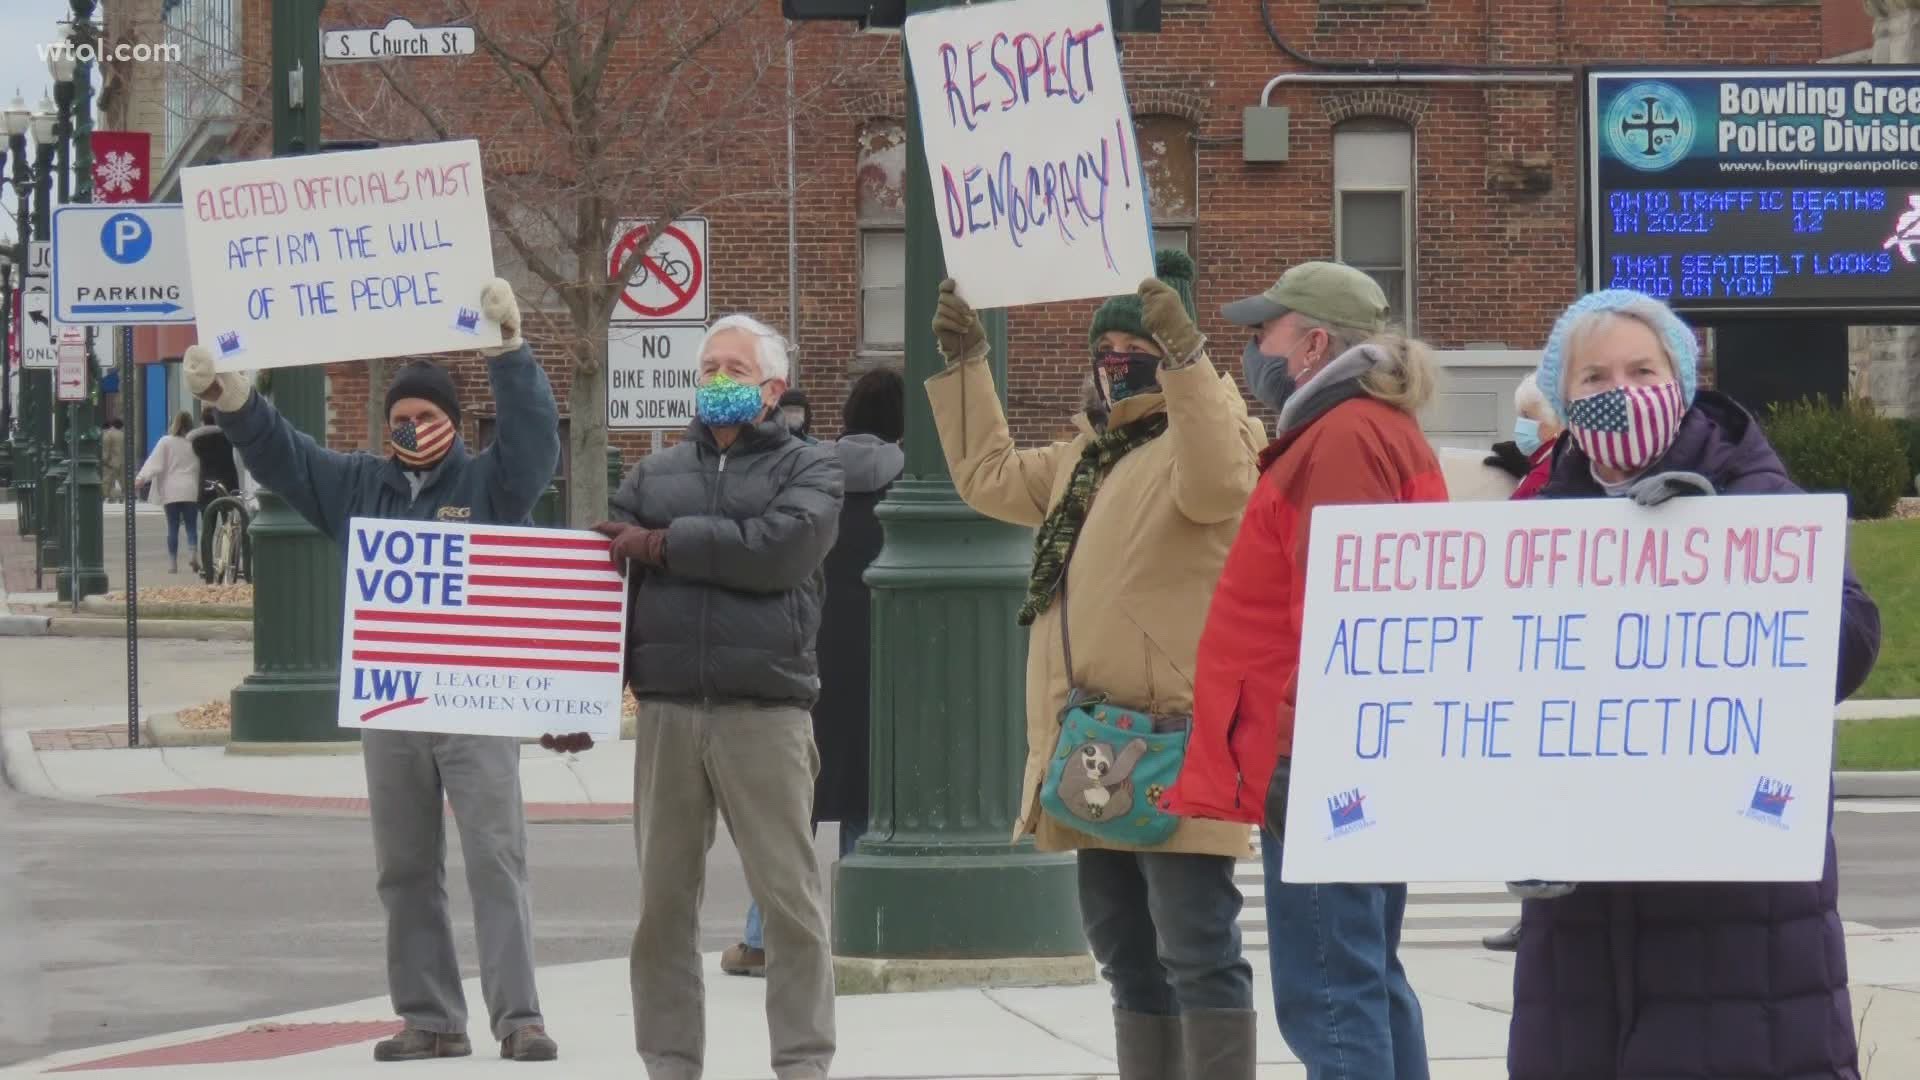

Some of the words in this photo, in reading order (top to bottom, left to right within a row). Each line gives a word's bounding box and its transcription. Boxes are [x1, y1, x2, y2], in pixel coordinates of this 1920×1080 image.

[339, 35, 356, 57] S.
[370, 32, 428, 55] Church
[938, 23, 1104, 131] RESPECT
[1720, 82, 1845, 118] Bowling
[1719, 119, 1817, 153] Police
[196, 180, 288, 221] ELECTED
[294, 168, 409, 211] OFFICIALS
[415, 162, 471, 200] MUST
[941, 118, 1131, 275] DEMOCRACY!
[1609, 190, 1669, 212] OHIO
[1679, 190, 1784, 212] TRAFFIC
[1791, 190, 1887, 211] DEATHS
[1613, 213, 1638, 233] IN
[1647, 213, 1714, 233] 2021:
[1793, 213, 1824, 233] 12
[228, 231, 320, 272] AFFIRM
[328, 225, 376, 260] THE
[388, 219, 452, 253] WILL
[1611, 255, 1672, 275] THAT
[1681, 254, 1804, 275] SEATBELT
[1813, 253, 1891, 274] LOOKS
[77, 286, 180, 301] PARKING
[248, 287, 275, 320] OF
[291, 281, 338, 317] THE
[351, 272, 443, 312] PEOPLE
[1681, 276, 1712, 296] ON
[1721, 276, 1773, 296] YOU!
[642, 335, 671, 359] NO
[612, 369, 645, 389] BIKE
[610, 400, 628, 418] ON
[357, 529, 465, 567] VOTE
[1333, 530, 1486, 593] ELECTED
[1504, 527, 1709, 589] OFFICIALS
[1724, 525, 1823, 584] MUST
[356, 568, 463, 606] VOTE
[1325, 615, 1483, 676] ACCEPT
[1512, 614, 1587, 672] THE
[1615, 610, 1808, 670] OUTCOME
[352, 667, 422, 701] LWV
[435, 671, 519, 690] LEAGUE
[526, 676, 554, 691] OF
[434, 692, 514, 711] WOMEN
[1355, 701, 1412, 760] OF
[1434, 701, 1514, 758] THE
[1538, 697, 1763, 757] ELECTION
